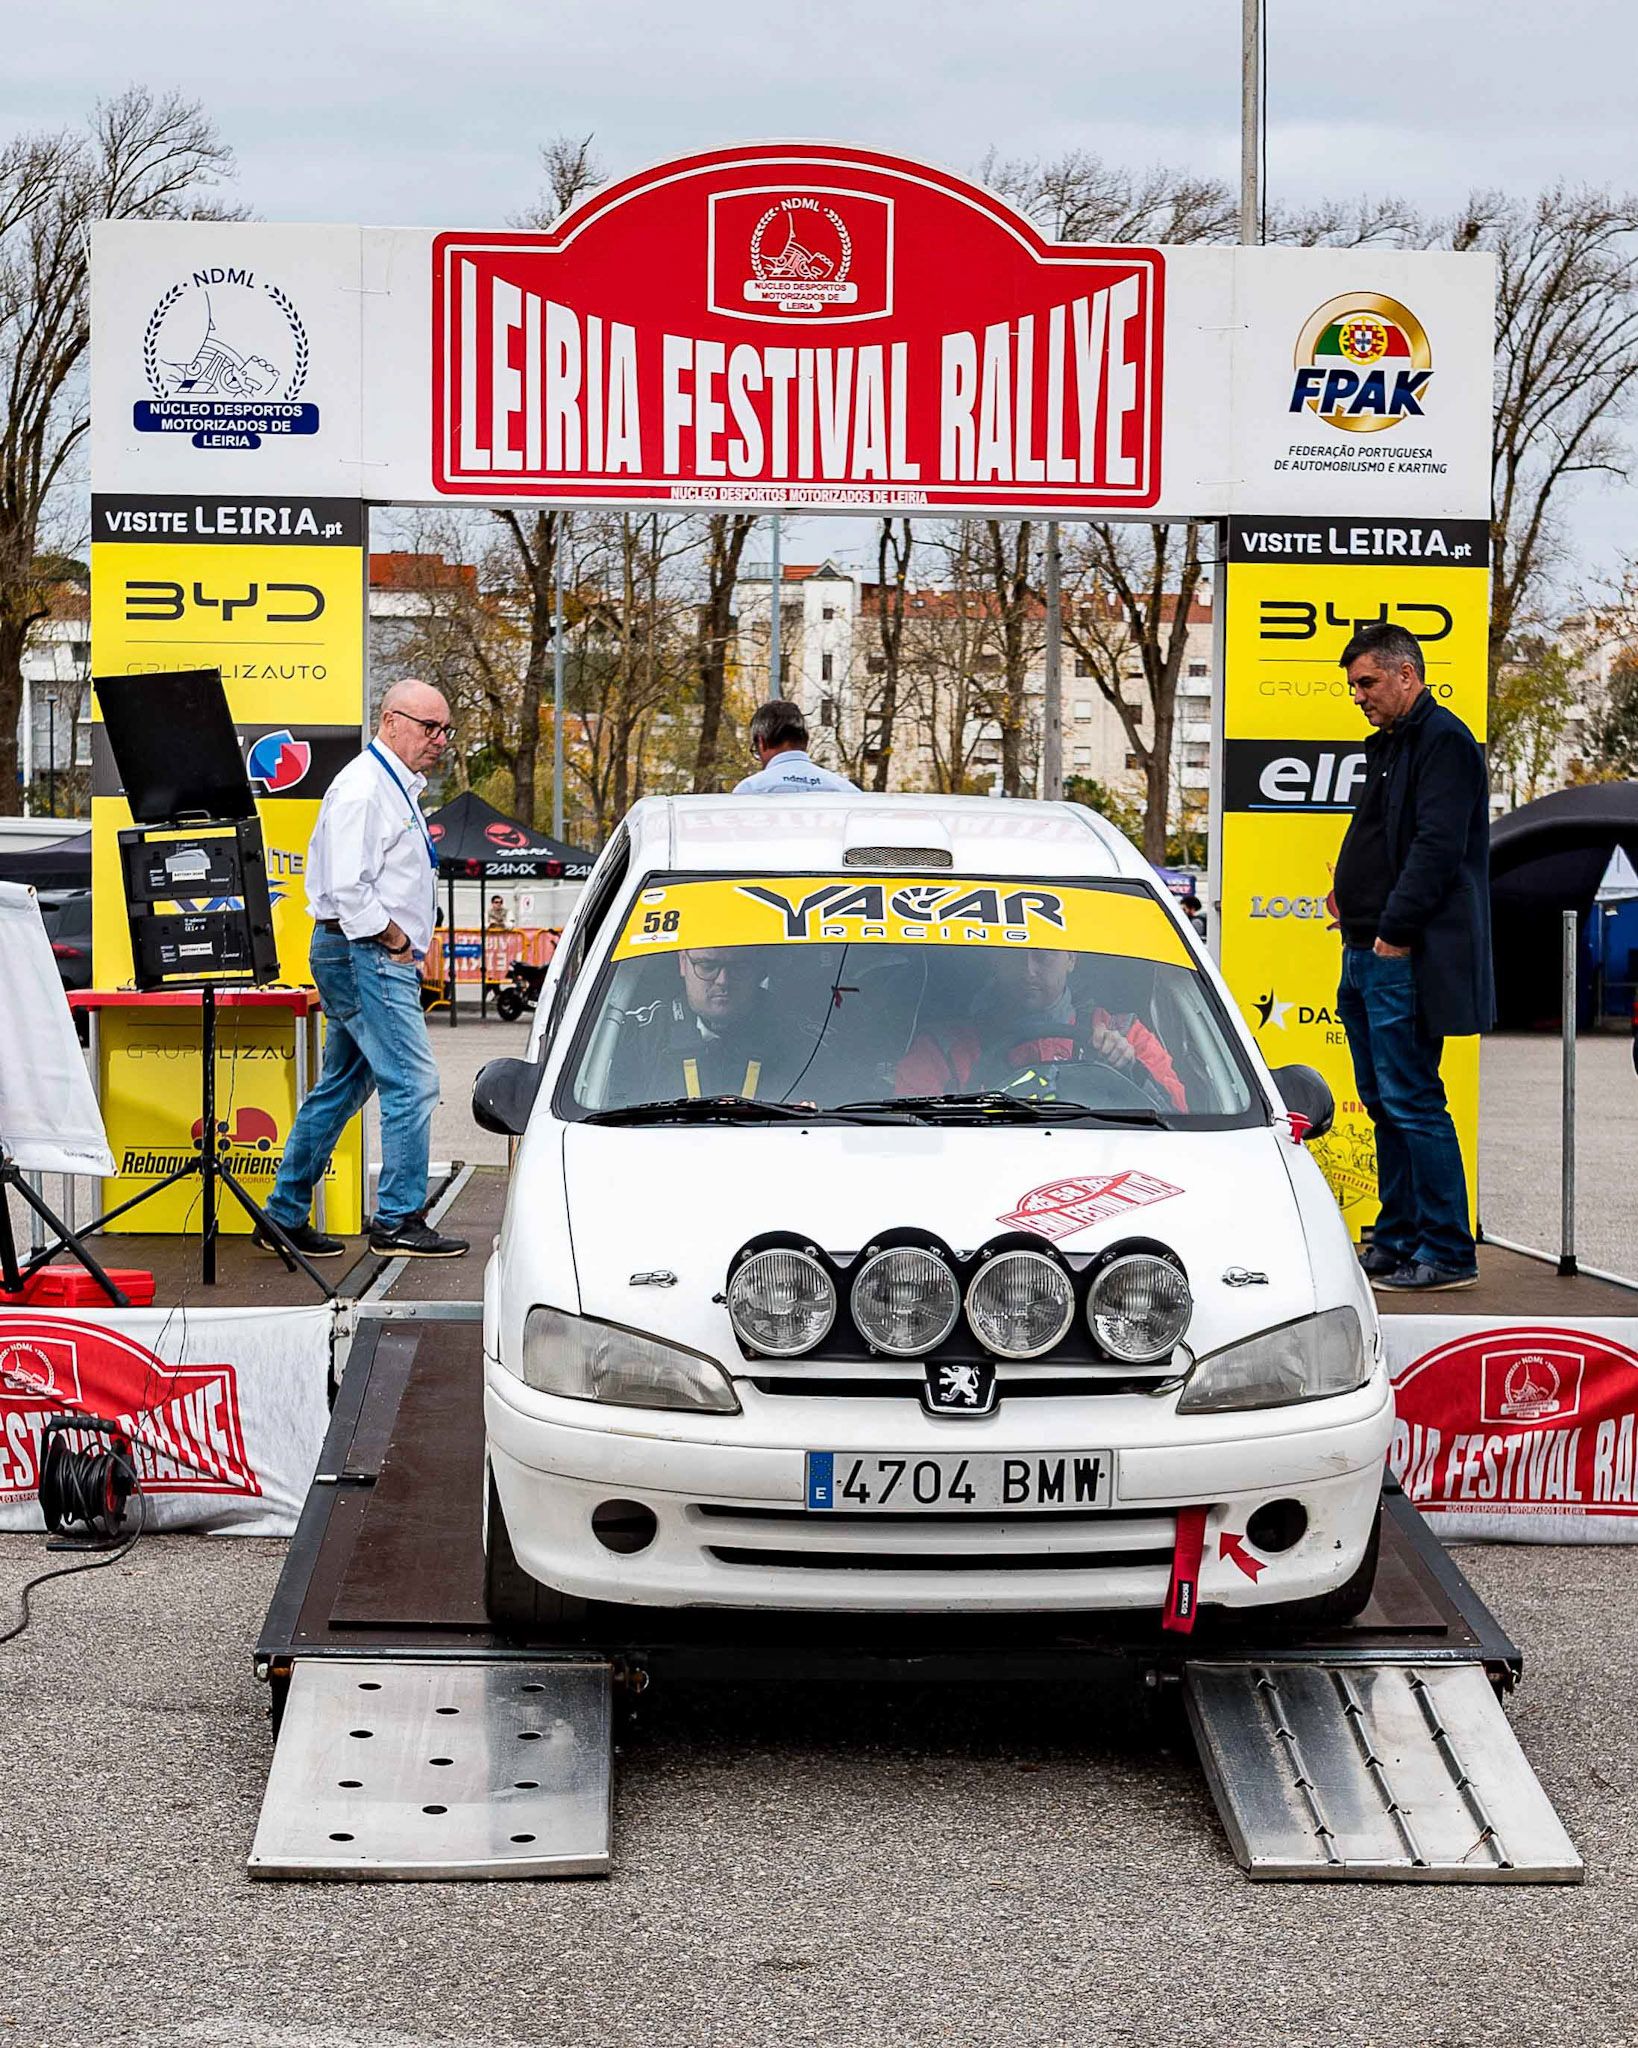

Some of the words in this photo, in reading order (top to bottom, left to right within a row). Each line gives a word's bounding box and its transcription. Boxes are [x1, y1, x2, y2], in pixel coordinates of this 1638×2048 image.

[782, 198, 820, 212] NDML
[193, 268, 254, 290] NDML
[793, 282, 847, 293] DESPORTOS
[828, 293, 840, 301] DE
[786, 302, 814, 311] LEIRIA
[459, 257, 642, 473] LEIRIA
[663, 333, 920, 481] FESTIVAL
[940, 273, 1139, 485] RALLYE
[1289, 368, 1434, 416] FPAK
[149, 401, 210, 418] NÚCLEO
[213, 402, 303, 418] DESPORTOS
[161, 419, 255, 434] MOTORIZADOS
[260, 419, 291, 433] DE
[202, 434, 250, 448] LEIRIA
[1288, 443, 1355, 459] FEDERAÇÃO
[1358, 447, 1433, 459] PORTUGUESA
[1274, 461, 1289, 471] DE
[1291, 461, 1385, 474] AUTOMOBILISMO
[1388, 463, 1395, 473] E
[1399, 463, 1448, 474] KARTING
[719, 487, 787, 502] DESPORTOS
[788, 488, 872, 504] MOTORIZADOS
[873, 490, 889, 504] DE
[890, 490, 928, 505] LEIRIA
[105, 511, 188, 535] VISITE
[194, 505, 343, 538] LEIRIA.pt
[1242, 531, 1323, 553] VISITE
[1328, 527, 1472, 560] LEIRIA.pt
[126, 581, 326, 623] BYD
[1260, 601, 1453, 641] BYD
[1258, 753, 1367, 802] elf
[485, 862, 537, 876] 24MX
[736, 885, 1063, 939] YACAR
[643, 910, 680, 933] 58
[821, 925, 1030, 941] RACING
[1049, 1186, 1086, 1201] 58
[1443, 1427, 1582, 1500] FESTIVAL
[816, 1487, 826, 1499] E
[842, 1460, 975, 1504] 4704
[1003, 1458, 1100, 1503] BMW
